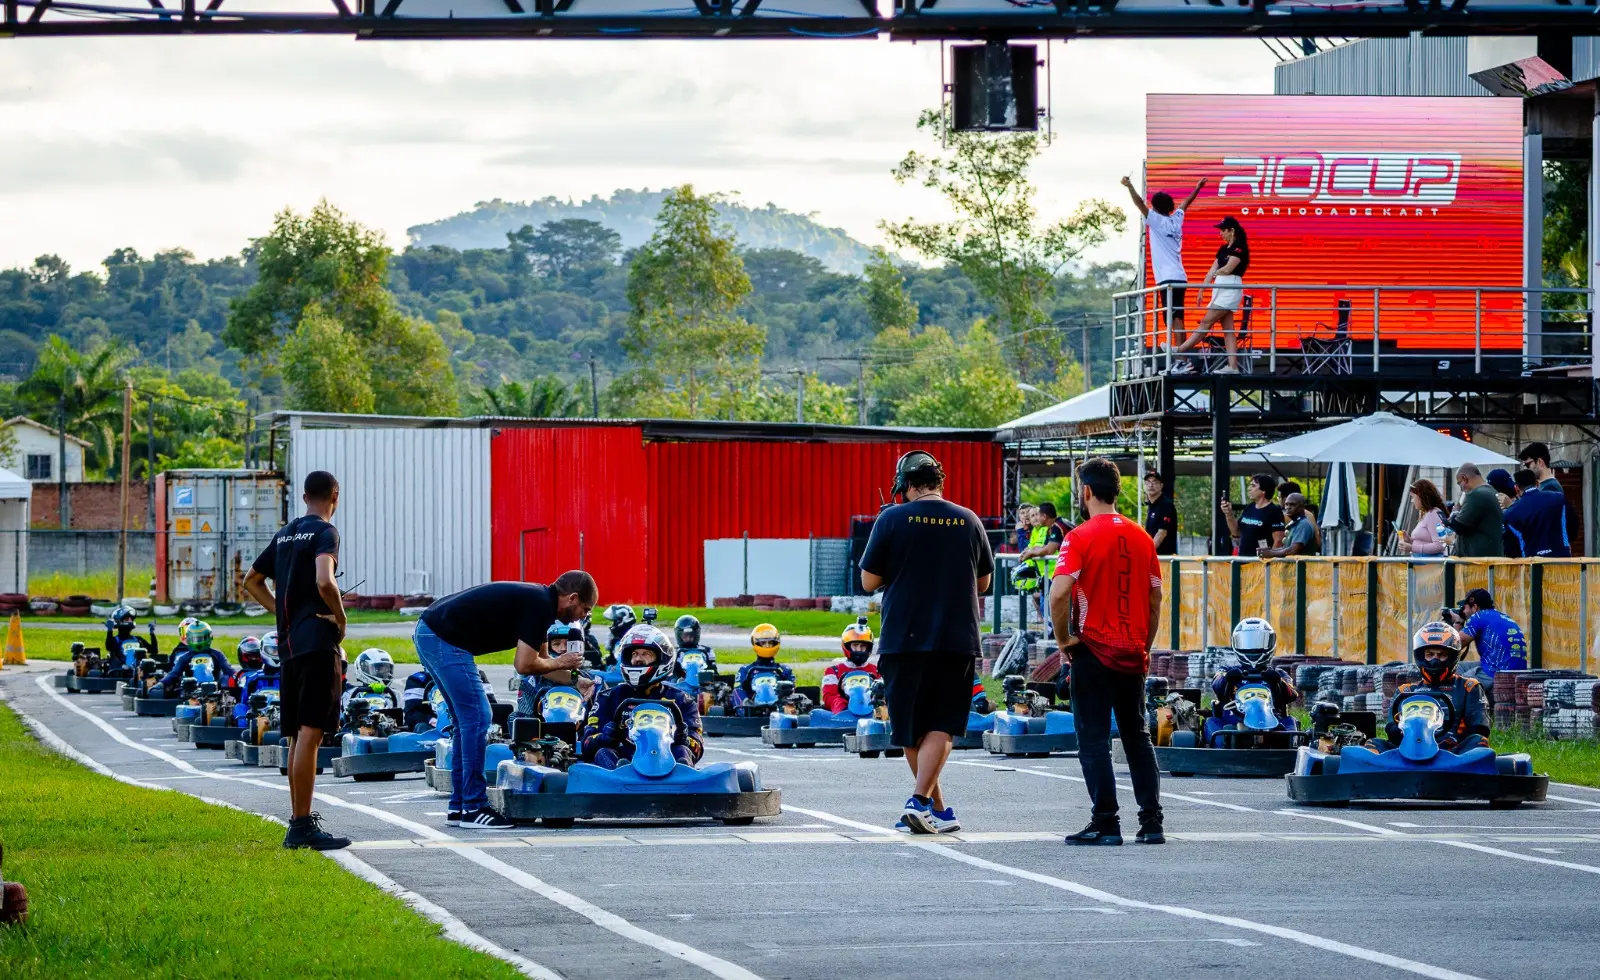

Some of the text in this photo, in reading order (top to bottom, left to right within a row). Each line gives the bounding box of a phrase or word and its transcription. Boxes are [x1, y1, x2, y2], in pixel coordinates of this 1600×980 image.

[1241, 207, 1439, 217] CARIOCA DE KART
[1438, 360, 1450, 370] 3
[908, 516, 965, 527] PRODUÇÃO
[553, 696, 578, 708] 15
